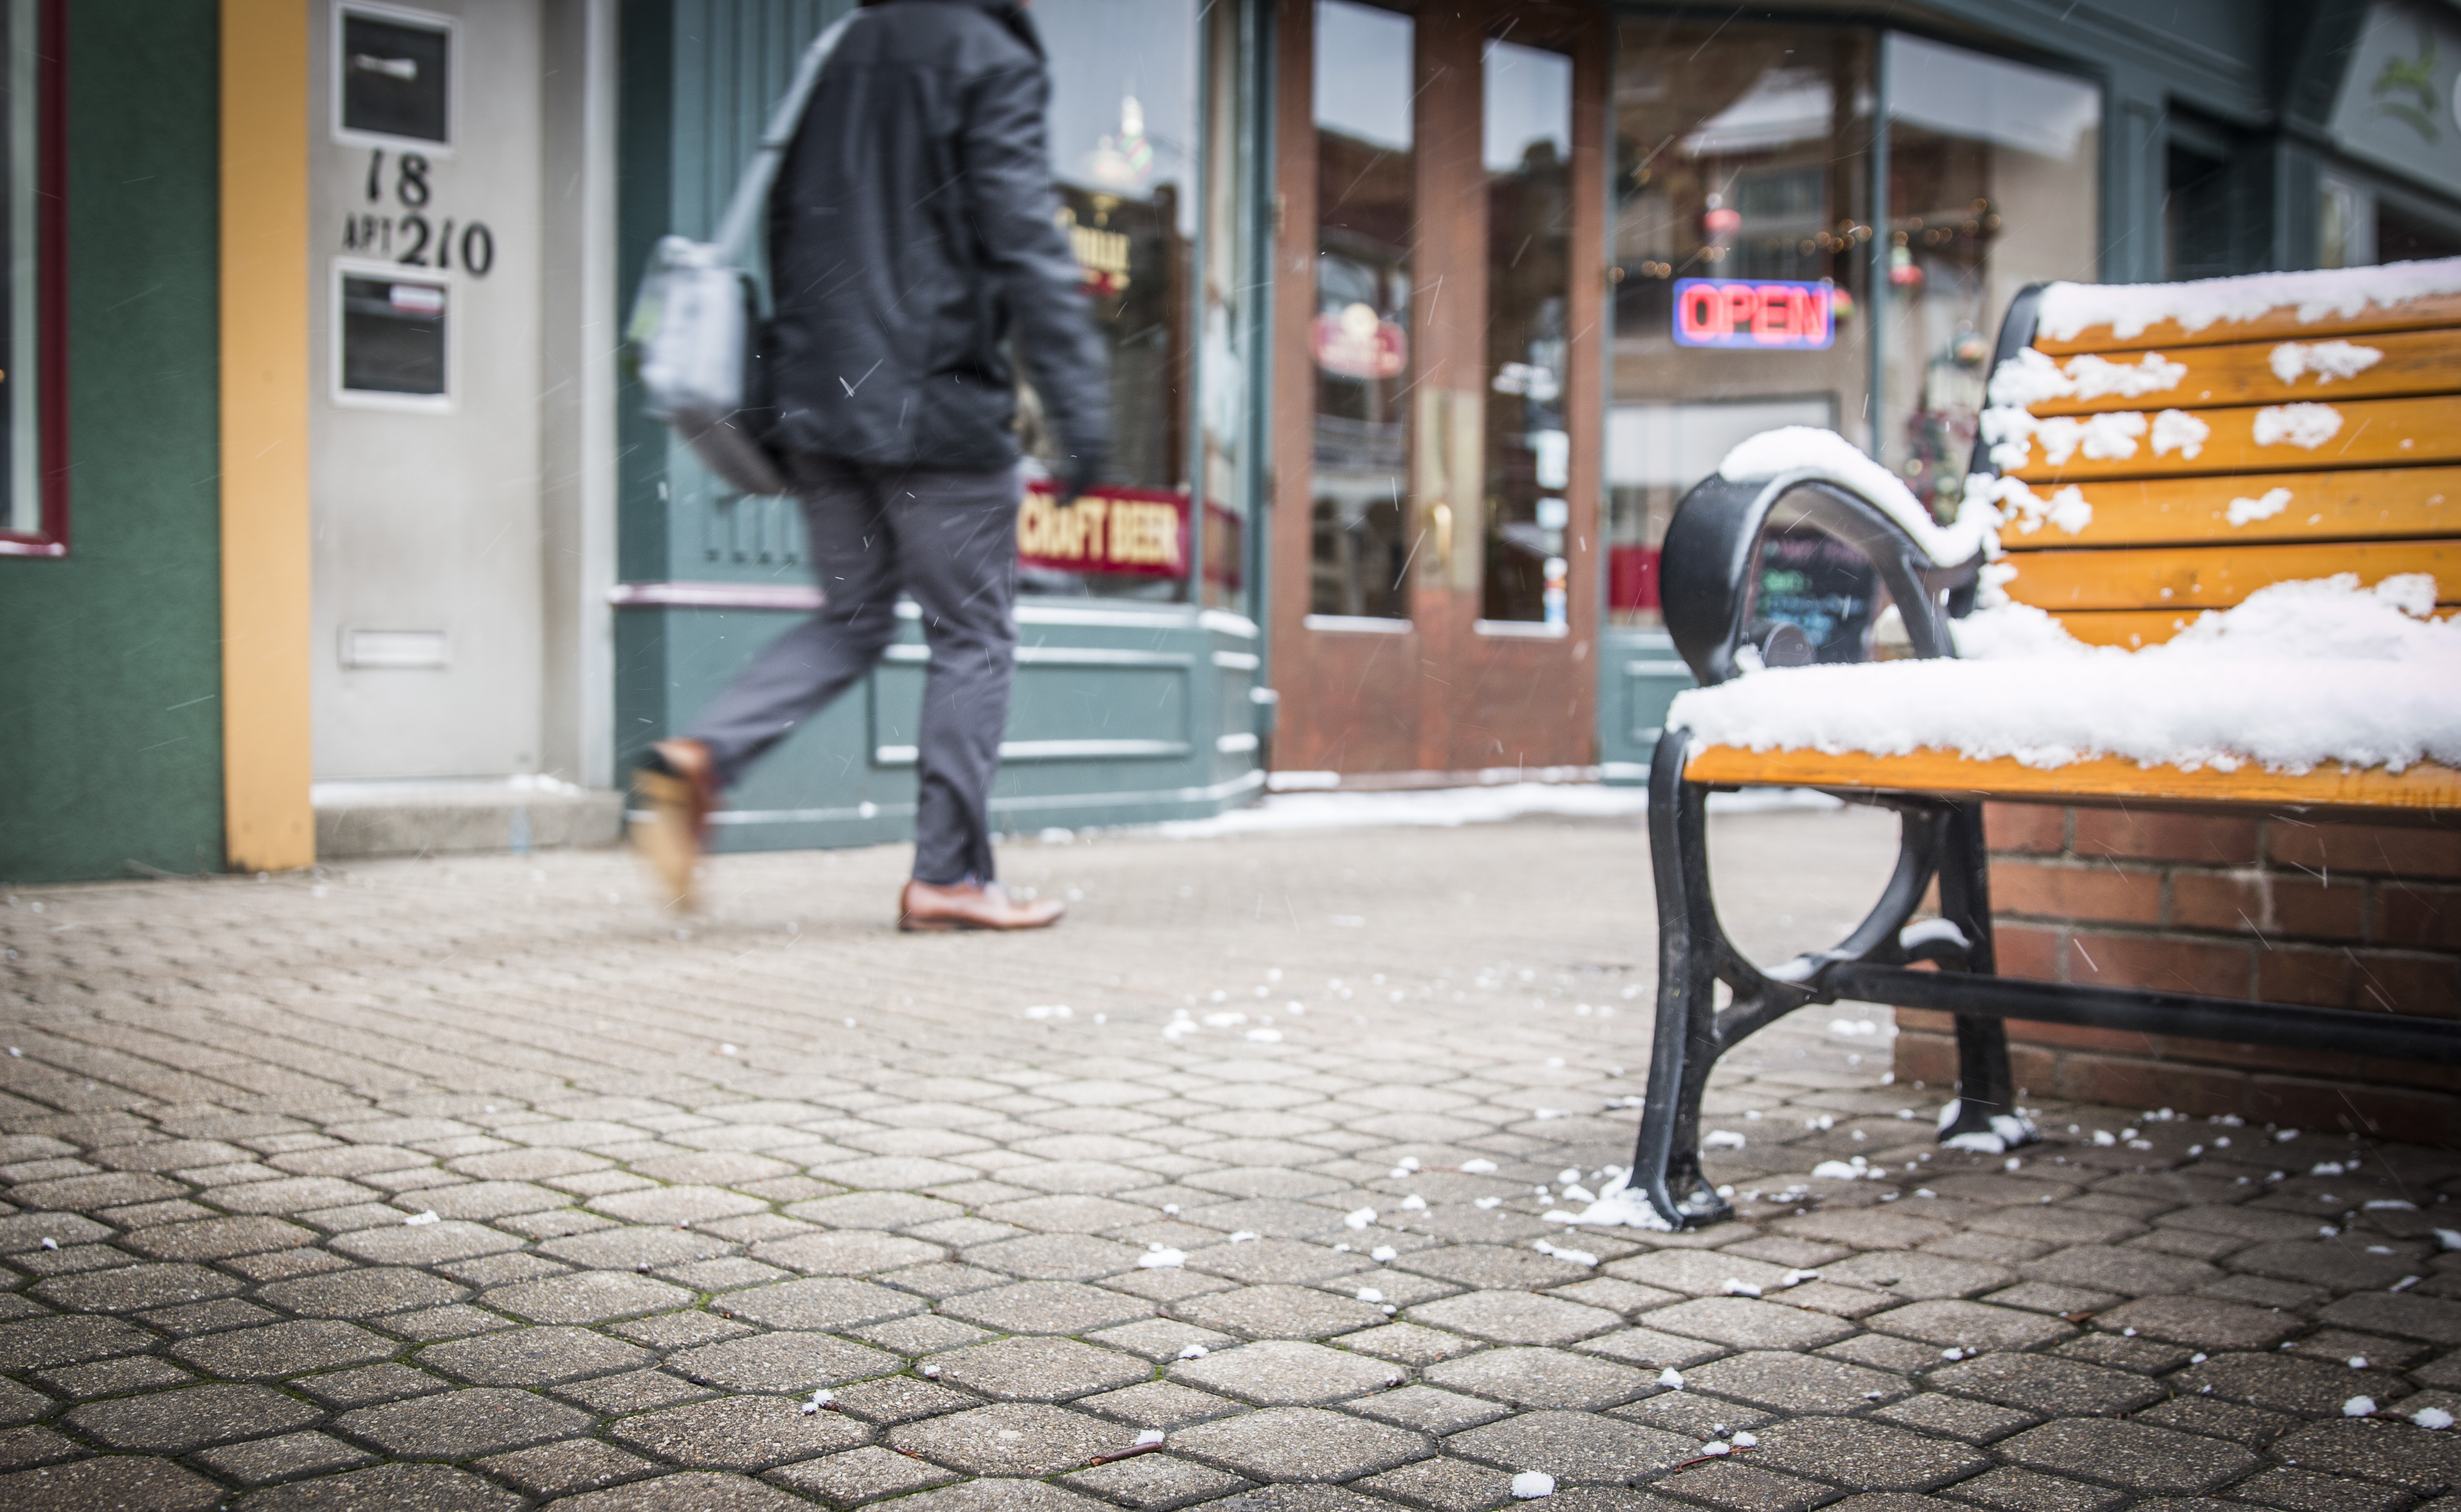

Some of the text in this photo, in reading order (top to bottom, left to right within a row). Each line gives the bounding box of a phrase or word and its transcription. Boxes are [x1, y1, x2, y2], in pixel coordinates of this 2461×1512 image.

[367, 147, 430, 209] 18
[397, 212, 496, 278] 210
[1679, 283, 1828, 346] OPEN
[1017, 492, 1181, 566] CRAFT BEER
